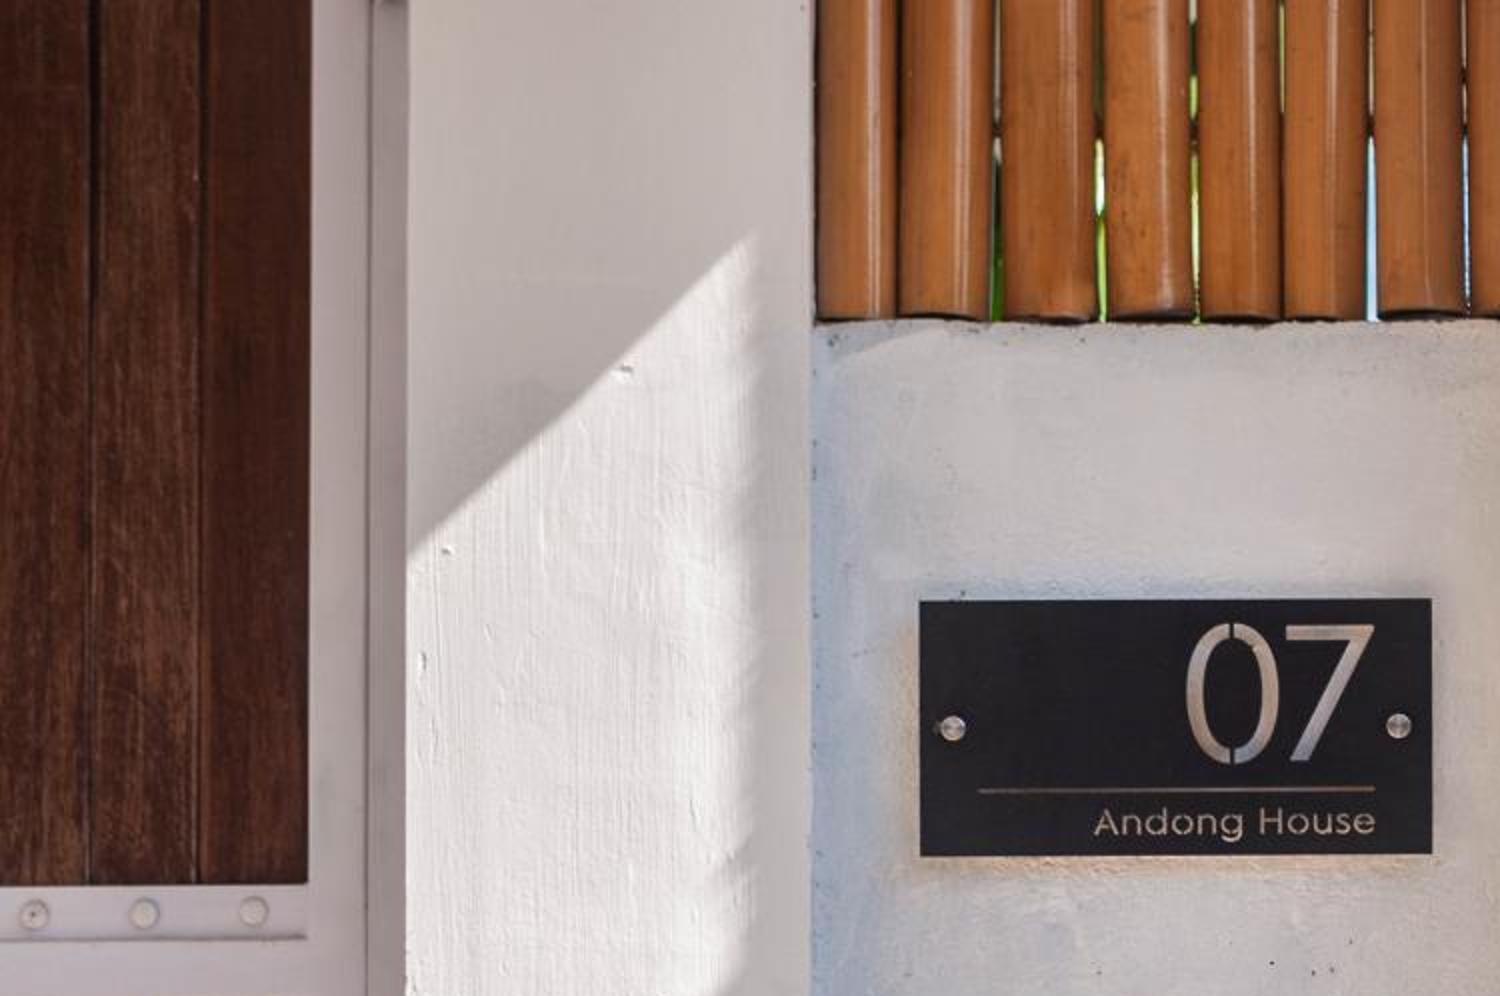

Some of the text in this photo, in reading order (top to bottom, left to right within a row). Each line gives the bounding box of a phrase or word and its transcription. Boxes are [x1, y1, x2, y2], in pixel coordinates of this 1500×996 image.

[1186, 622, 1375, 764] 07
[1093, 807, 1376, 843] Andong House
